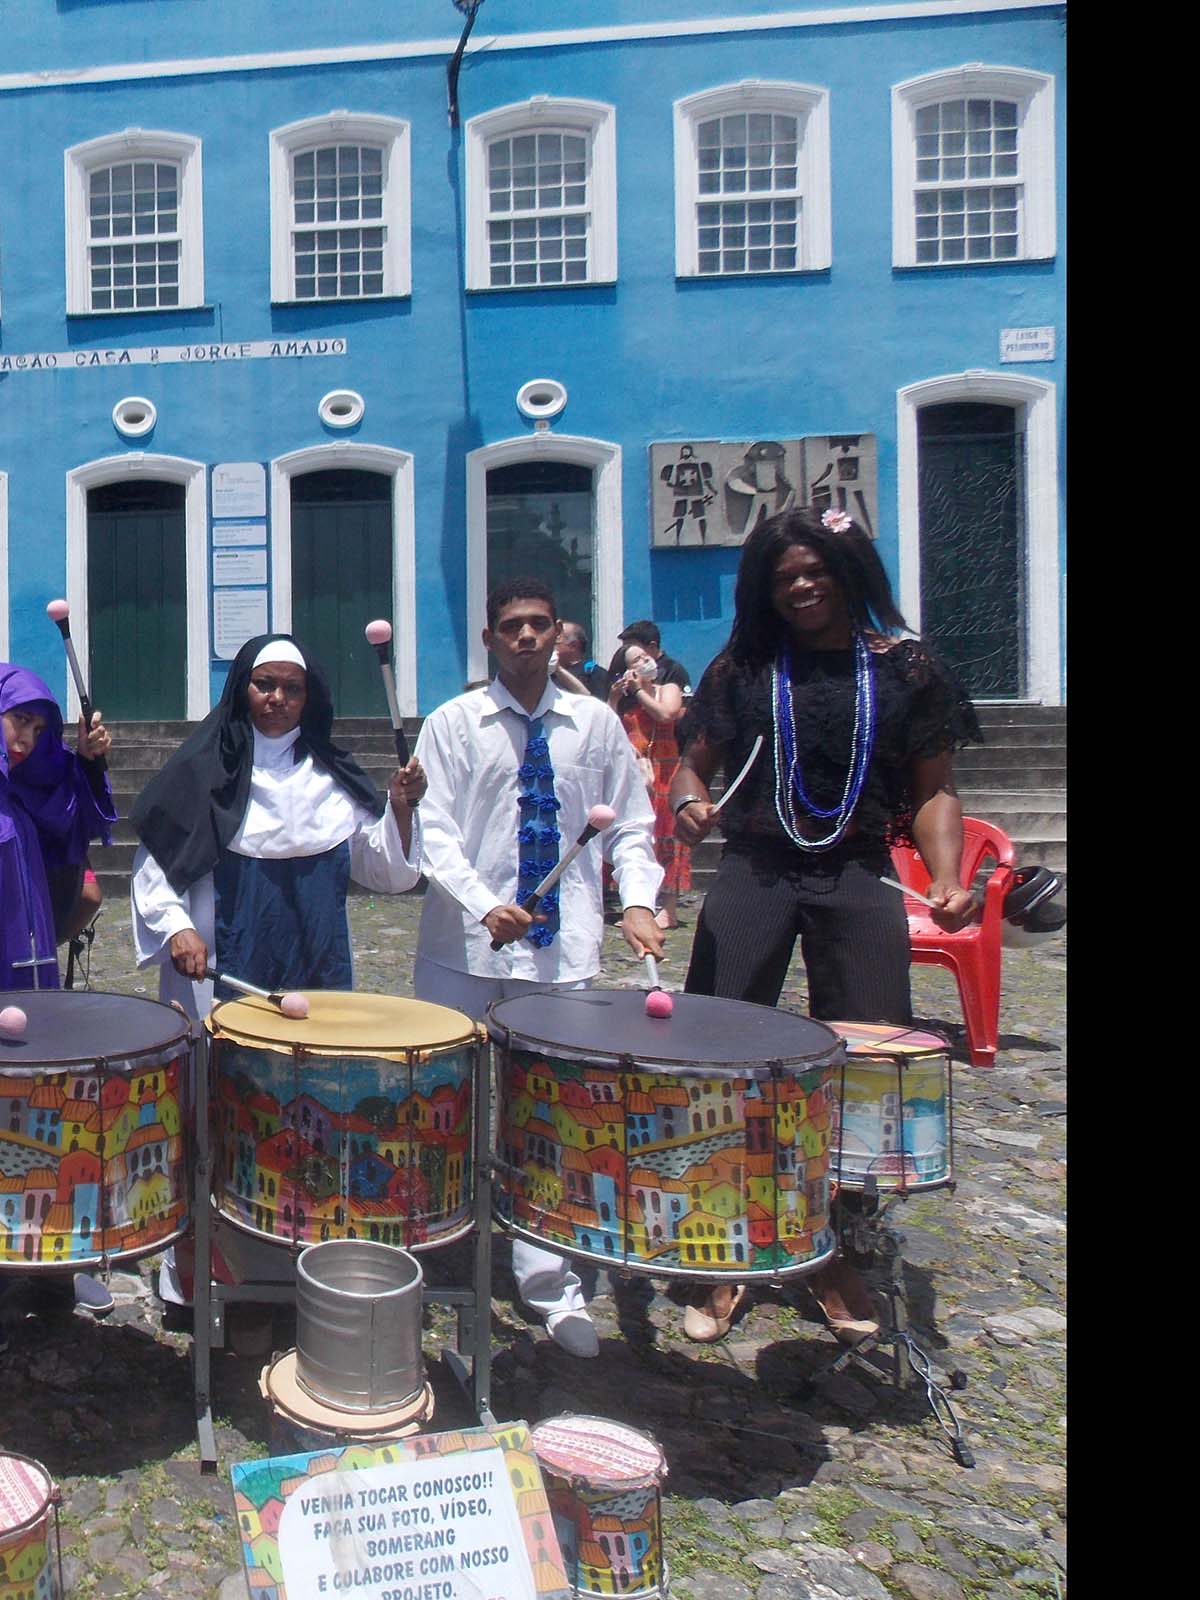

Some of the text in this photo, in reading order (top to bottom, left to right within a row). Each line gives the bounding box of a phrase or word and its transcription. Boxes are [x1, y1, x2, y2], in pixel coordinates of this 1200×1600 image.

[75, 350, 132, 366] CASA
[180, 344, 251, 361] JORGE
[271, 339, 345, 356] AMADO
[300, 1471, 494, 1516] VENHA TOCAR CONOSCO!!
[358, 1513, 387, 1533] SUA
[392, 1506, 435, 1529] FOTO,
[440, 1497, 492, 1520] VÍDEO,
[366, 1528, 456, 1558] BOMERANG
[318, 1575, 327, 1592] E
[420, 1554, 455, 1576] COM
[460, 1546, 509, 1570] NOSSO
